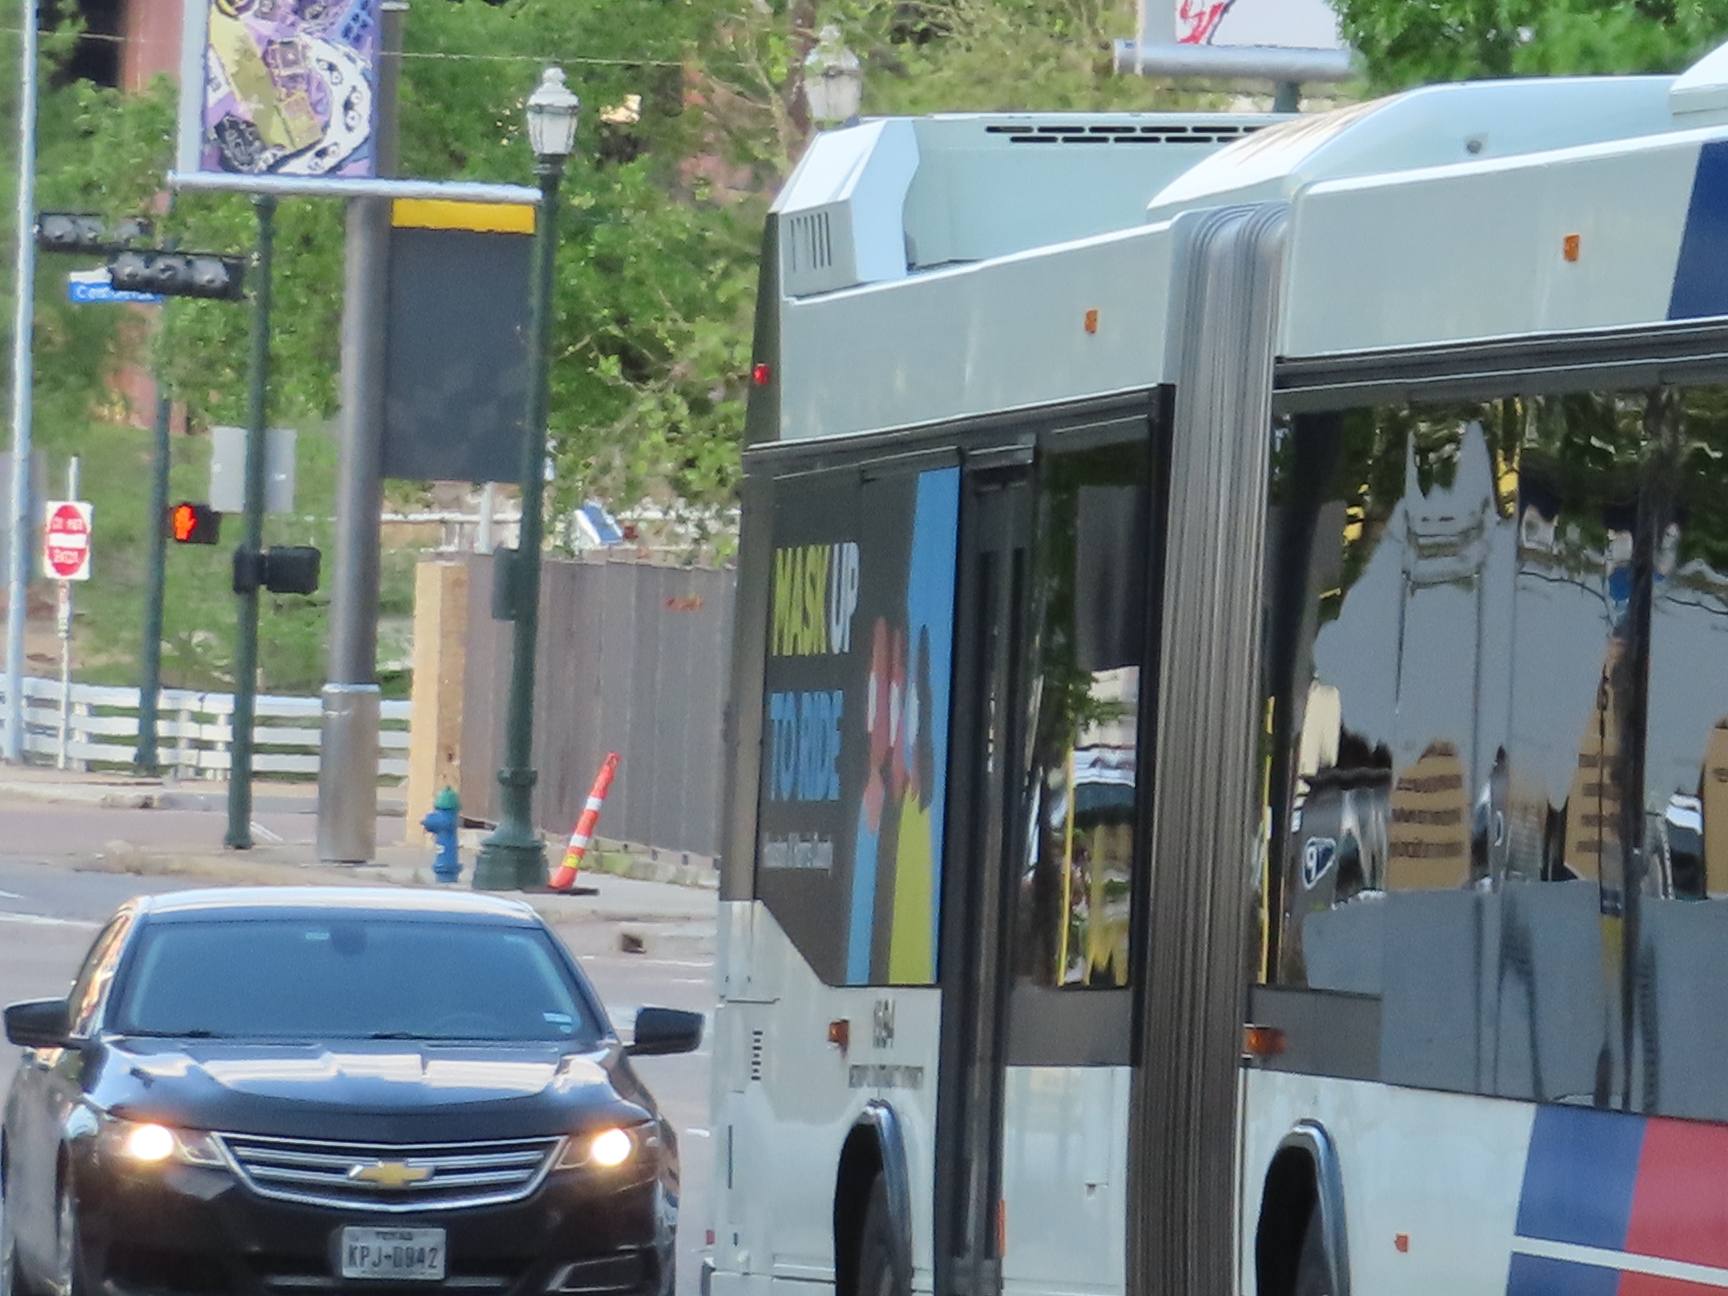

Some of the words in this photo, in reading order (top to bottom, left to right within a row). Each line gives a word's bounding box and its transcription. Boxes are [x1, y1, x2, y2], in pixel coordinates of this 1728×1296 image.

[773, 544, 830, 657] MASK
[831, 542, 860, 655] UP
[770, 690, 798, 801] TO
[798, 688, 844, 801] RIDE
